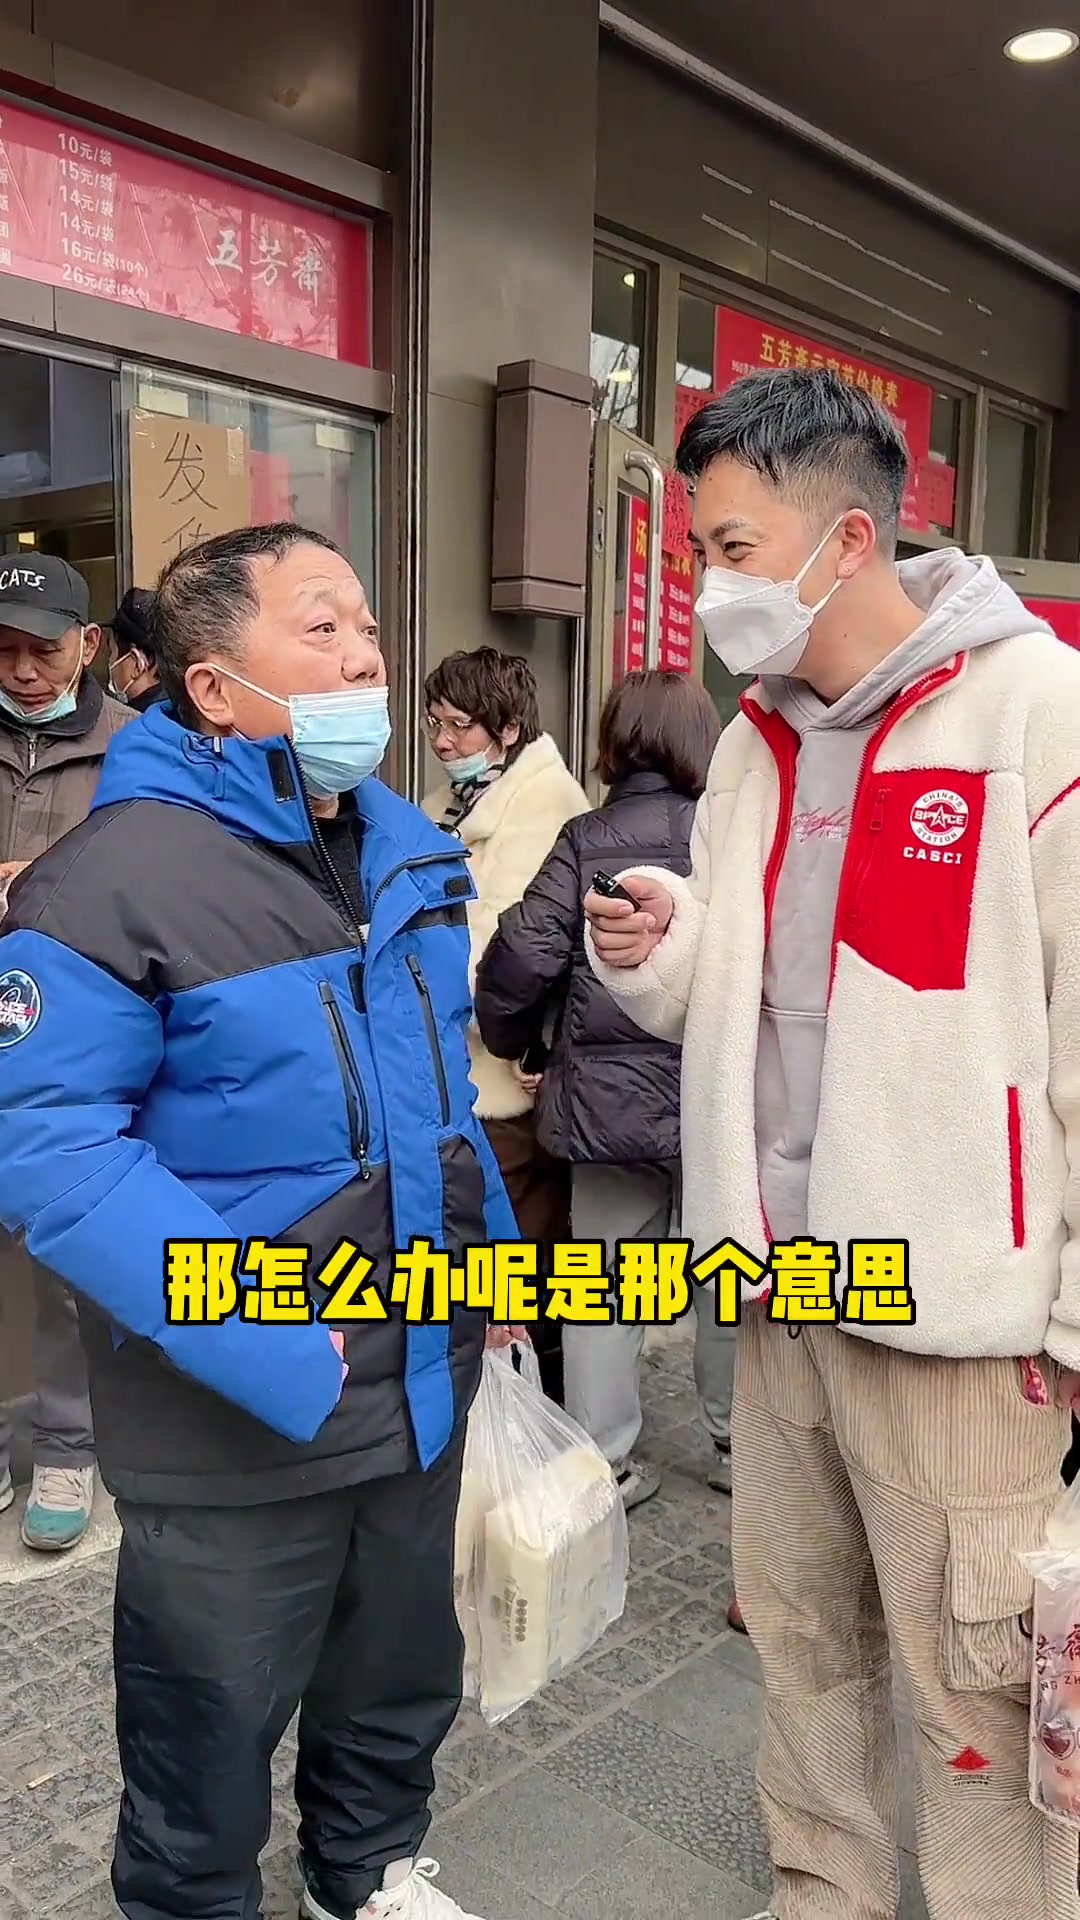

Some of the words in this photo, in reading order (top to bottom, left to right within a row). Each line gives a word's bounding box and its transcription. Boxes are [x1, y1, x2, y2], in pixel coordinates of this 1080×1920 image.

[58, 132, 112, 167] 10元/袋
[59, 158, 113, 192] 15元/袋
[60, 185, 113, 218] 14元/袋
[60, 211, 114, 243] 14元/袋
[922, 791, 964, 808] CHINA'S
[913, 806, 966, 828] SPACE
[916, 827, 958, 844] STATION
[903, 846, 963, 864] CASCI
